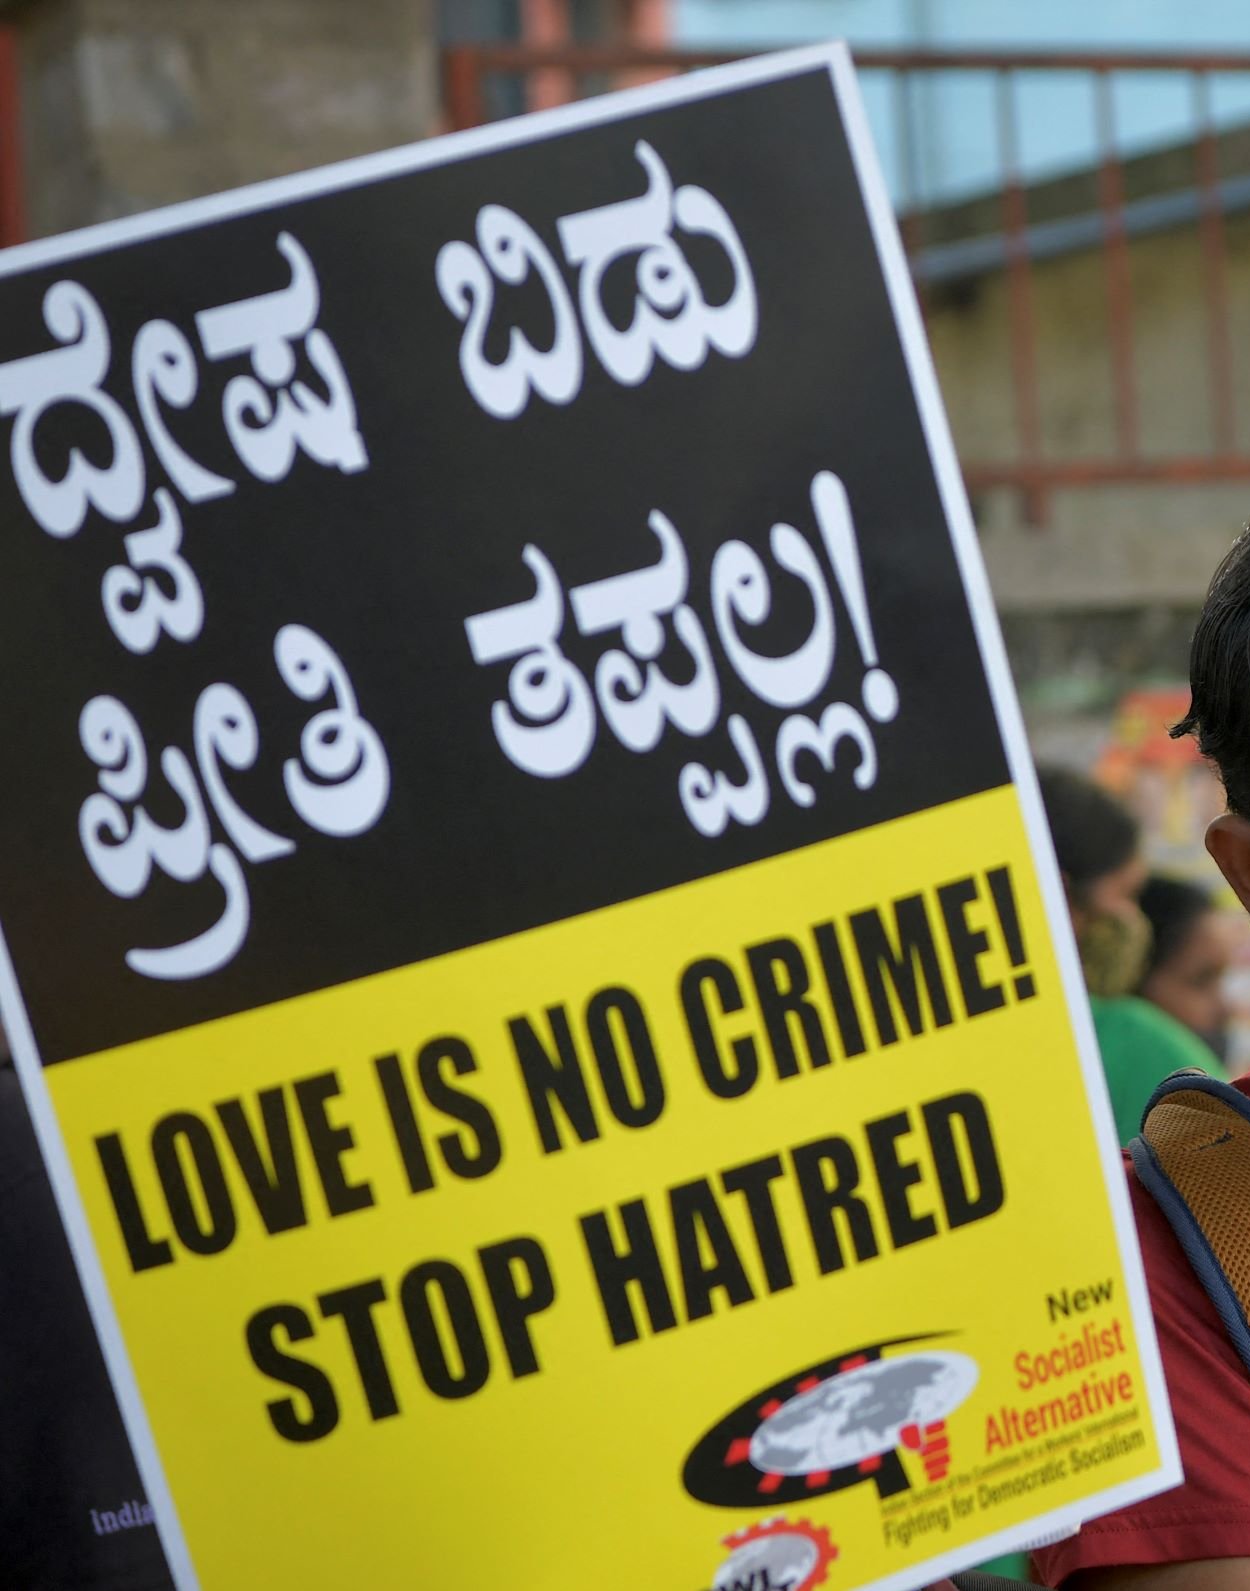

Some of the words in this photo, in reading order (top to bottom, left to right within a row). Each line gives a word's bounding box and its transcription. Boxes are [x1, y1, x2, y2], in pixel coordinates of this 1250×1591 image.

[0, 232, 369, 653] ದ್ವೇಷ
[435, 139, 759, 420] ಬಿಡು
[78, 623, 391, 980] ಪ್ರೀತಿ
[463, 469, 899, 838] ತಪ್ಪಲ್ಲ!
[94, 1070, 375, 1274] LOVE
[374, 1035, 503, 1195] IS
[507, 986, 667, 1155] NO
[679, 865, 1036, 1100] CRIME!
[245, 1236, 556, 1444] STOP
[579, 1091, 1006, 1347] HATRED
[1015, 1319, 1126, 1391] Socialist
[1047, 1279, 1114, 1325] New
[985, 1372, 1134, 1455] Alternative
[1068, 1427, 1146, 1478] Socialism
